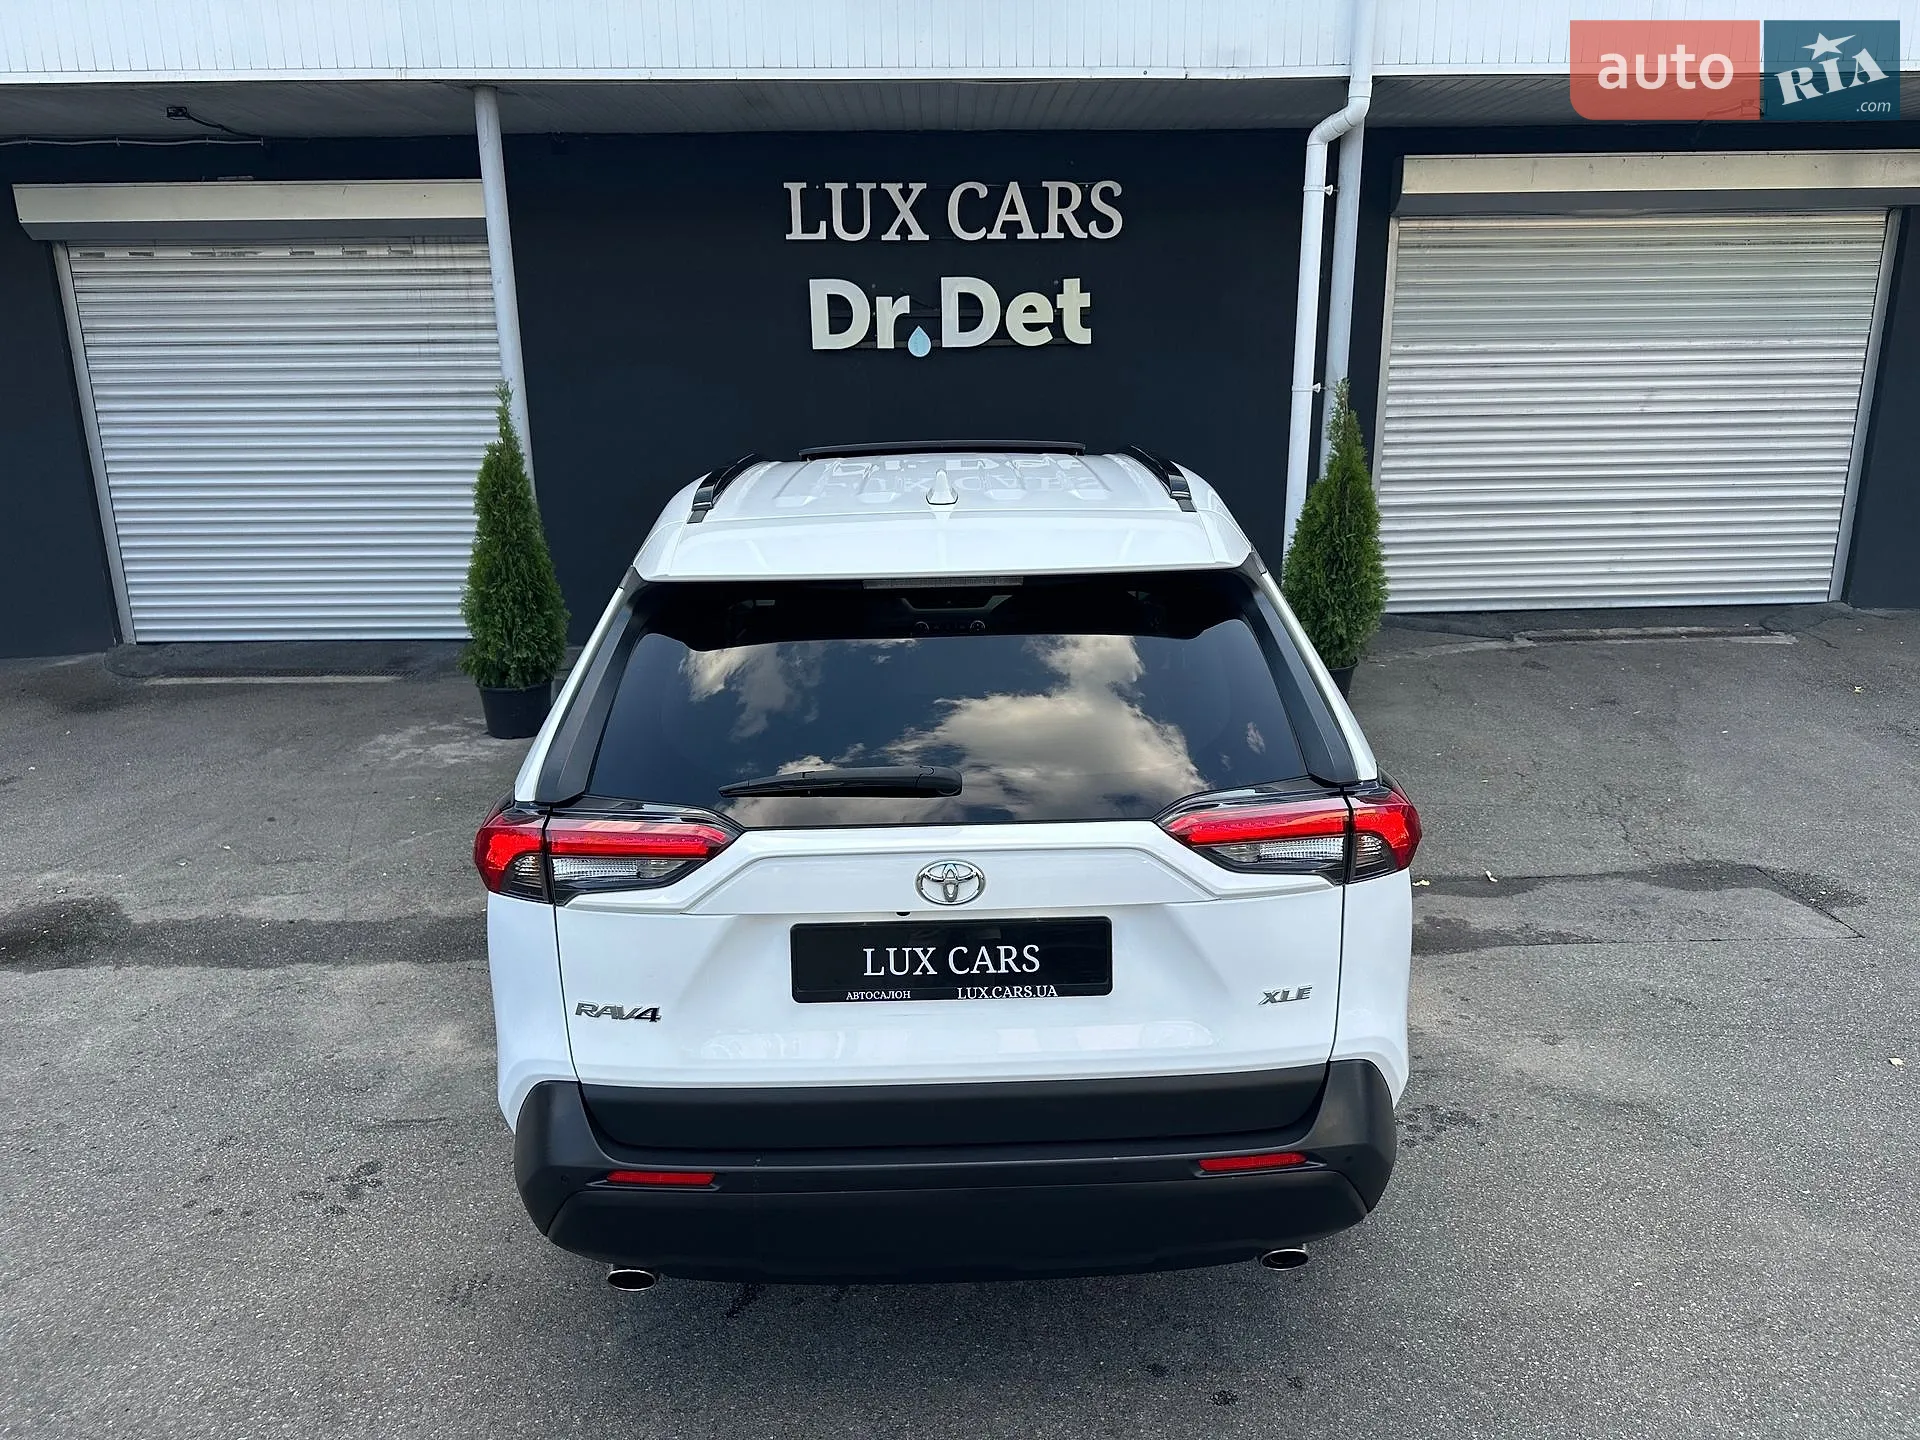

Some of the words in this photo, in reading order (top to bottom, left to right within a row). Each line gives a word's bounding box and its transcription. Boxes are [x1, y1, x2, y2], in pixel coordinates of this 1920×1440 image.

[783, 181, 930, 241] LUX
[947, 181, 1124, 240] CARS
[863, 946, 937, 976] LUX
[948, 944, 1040, 974] CARS
[846, 990, 911, 1000] АВТОСАЛОН
[957, 985, 1058, 999] LUX.CARS.UA
[1260, 985, 1313, 1005] XLE
[575, 1002, 661, 1022] RAV4
